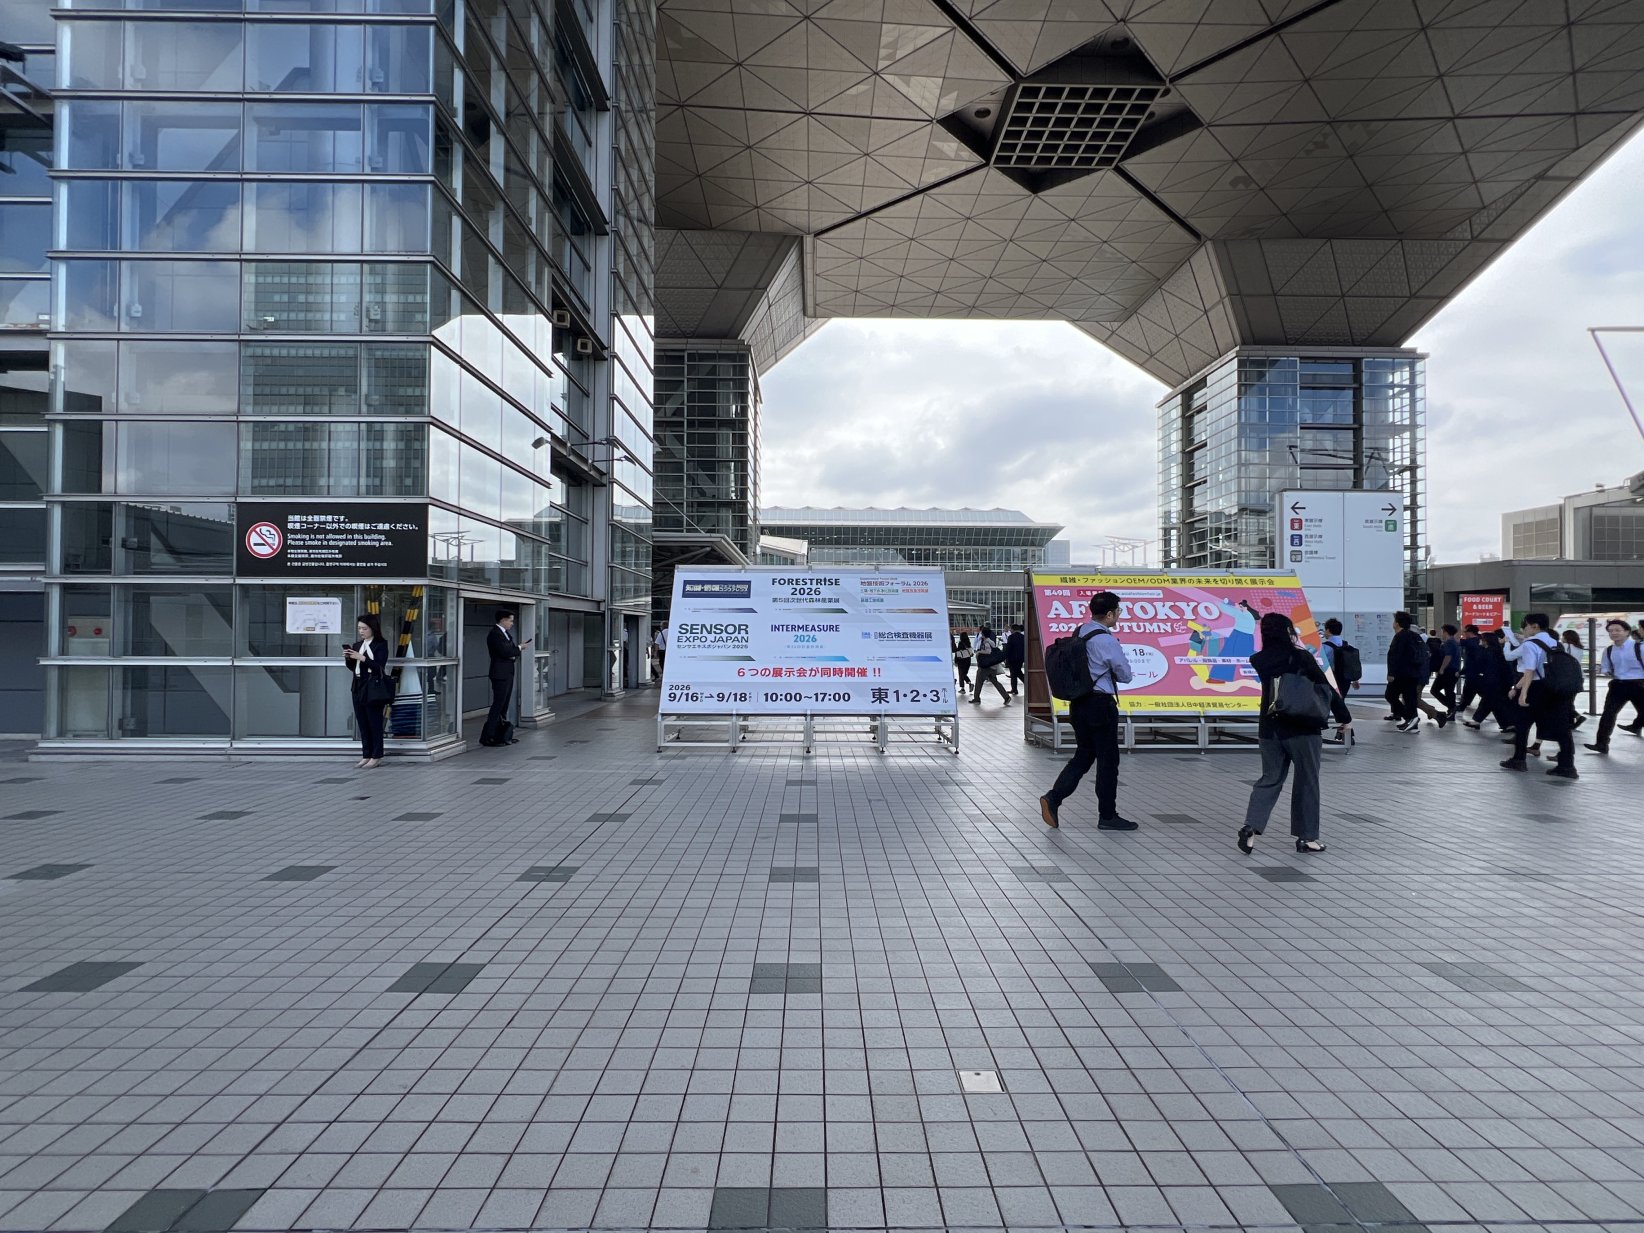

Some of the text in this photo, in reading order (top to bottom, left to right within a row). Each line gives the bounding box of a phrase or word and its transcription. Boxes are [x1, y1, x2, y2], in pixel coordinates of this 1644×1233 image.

[771, 577, 840, 586] FORESTRISE
[790, 587, 821, 596] 2026
[1044, 589, 1071, 597] 第49回
[1118, 601, 1221, 620] TOKYO
[678, 623, 749, 635] SENSOR
[771, 624, 840, 632] INTERMEASURE
[1109, 622, 1172, 633] UTUMN
[793, 634, 817, 643] 2026
[878, 631, 933, 640] 総合検査機器展
[1132, 648, 1145, 657] 18
[668, 692, 699, 703] 9/16
[716, 692, 748, 703] 9/18
